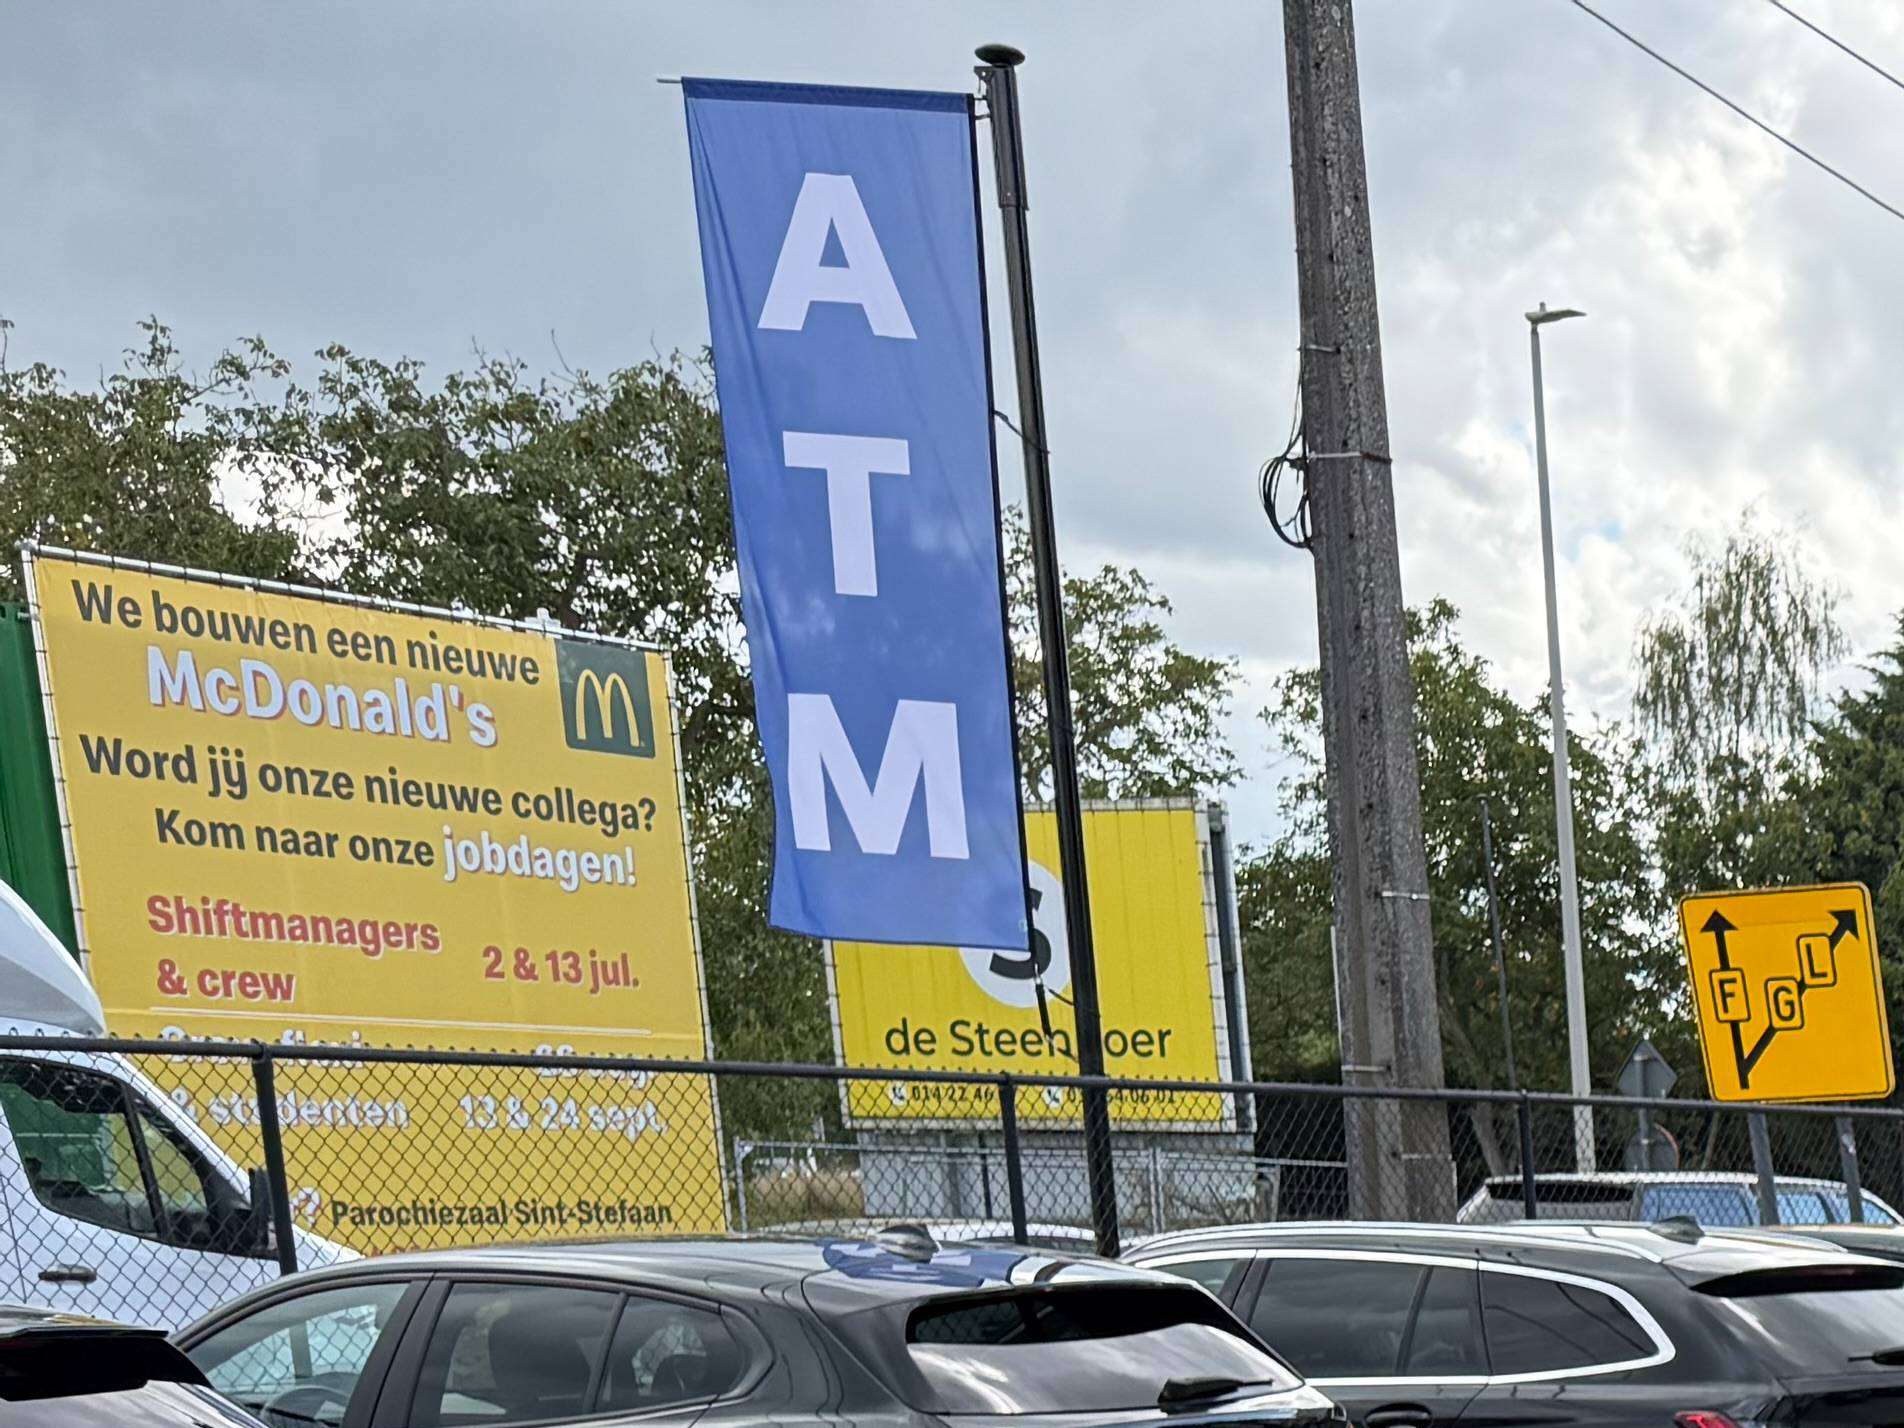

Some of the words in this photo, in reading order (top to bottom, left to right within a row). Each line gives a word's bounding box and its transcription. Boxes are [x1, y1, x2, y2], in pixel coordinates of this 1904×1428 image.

[70, 579, 143, 629] We
[151, 589, 318, 654] bouwen
[327, 623, 397, 666] een
[406, 630, 540, 685] nieuwe
[147, 645, 498, 748] McDonald's
[79, 733, 198, 785] Word
[207, 744, 248, 801] jij
[258, 762, 355, 801] onze
[364, 766, 503, 816] nieuwe
[511, 787, 657, 838] collega?
[154, 807, 246, 851] Kom
[255, 824, 339, 859] naar
[349, 833, 435, 867] onze
[442, 824, 638, 892] jobdagen!
[146, 894, 443, 959] Shiftmanagers
[156, 957, 189, 998] &
[196, 966, 296, 1002] crew
[482, 945, 505, 980] 2
[512, 947, 539, 982] &
[545, 949, 583, 984] 13
[589, 949, 640, 994] jul.
[1805, 943, 1828, 978] L
[1718, 977, 1737, 1014] F
[1773, 985, 1796, 1022] G
[885, 1017, 937, 1056] de
[950, 1019, 1172, 1058] Steenoer
[331, 1197, 509, 1228] Parochiezaal
[515, 1198, 673, 1227] Sint-Stefaan
